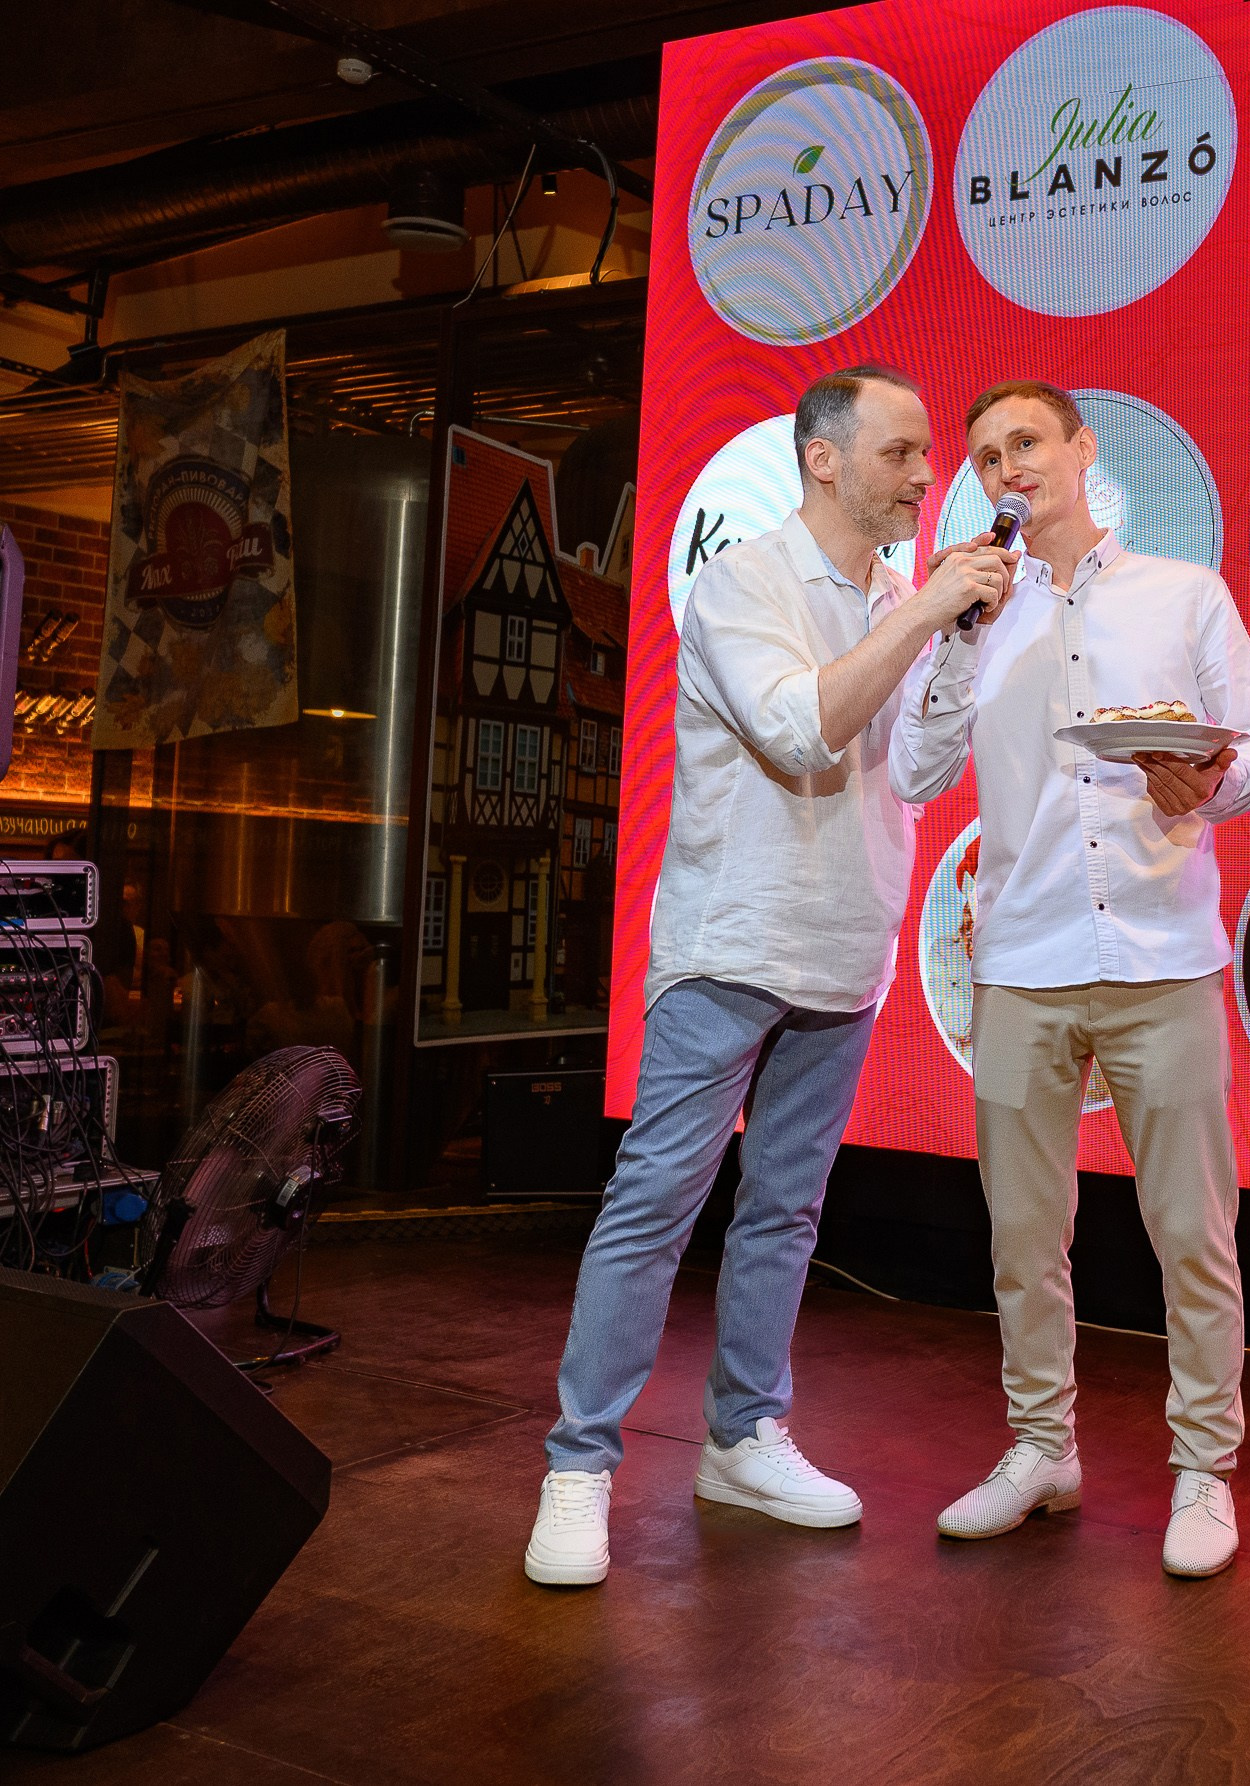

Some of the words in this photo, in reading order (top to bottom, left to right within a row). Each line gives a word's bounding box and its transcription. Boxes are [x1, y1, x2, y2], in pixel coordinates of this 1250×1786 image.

[969, 132, 1216, 205] BLANZÓ
[1004, 83, 1164, 187] Julia
[705, 170, 915, 238] SPADAY
[989, 211, 1036, 228] ЦЕНТР
[1046, 199, 1130, 220] ЭСТЕТИКИ
[1141, 191, 1192, 208] ВОЛОС
[531, 1082, 562, 1093] BOSS
